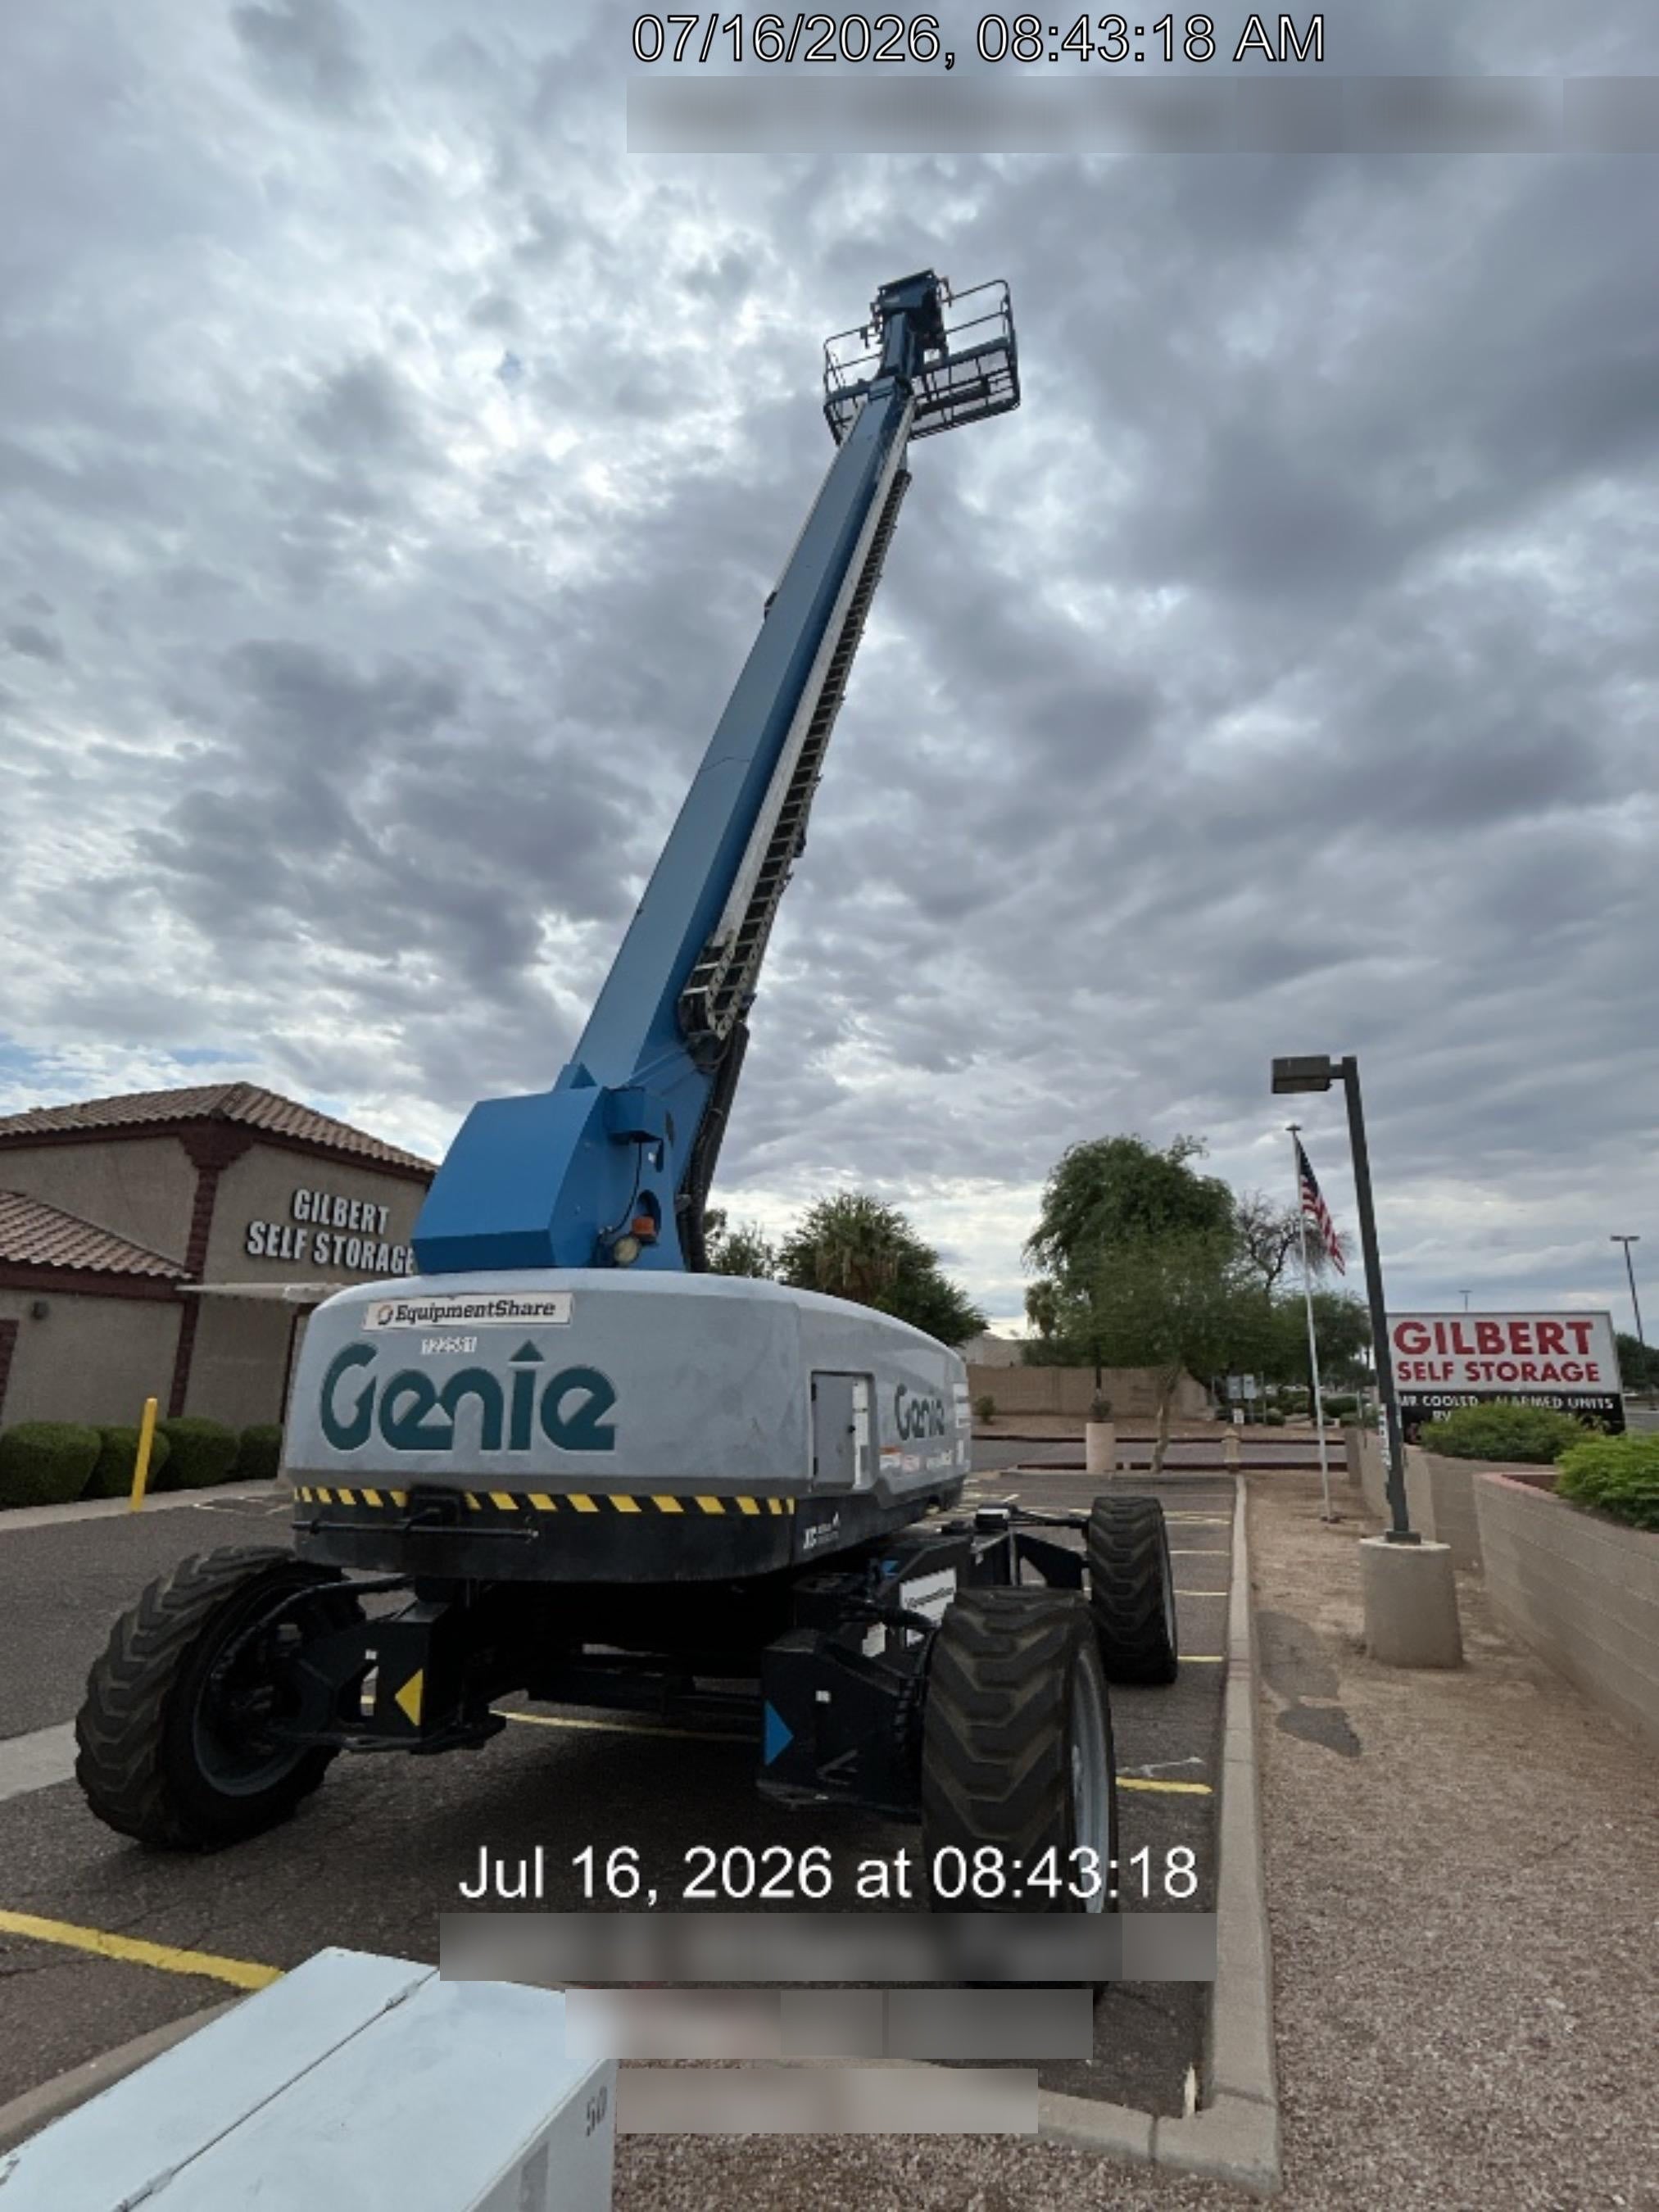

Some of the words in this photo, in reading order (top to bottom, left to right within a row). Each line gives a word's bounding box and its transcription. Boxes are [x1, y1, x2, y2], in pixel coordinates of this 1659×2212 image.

[292, 1189, 389, 1235] GILBERT
[247, 1221, 308, 1260] SELF
[395, 1299, 556, 1325] EquipmentShare
[1394, 1321, 1593, 1356] GILBERT
[1397, 1361, 1455, 1383] SELF
[1465, 1361, 1600, 1383] STORAGE
[320, 1339, 617, 1452] Genie
[1422, 1395, 1479, 1407] COOLED
[1567, 1397, 1614, 1410] UNITS
